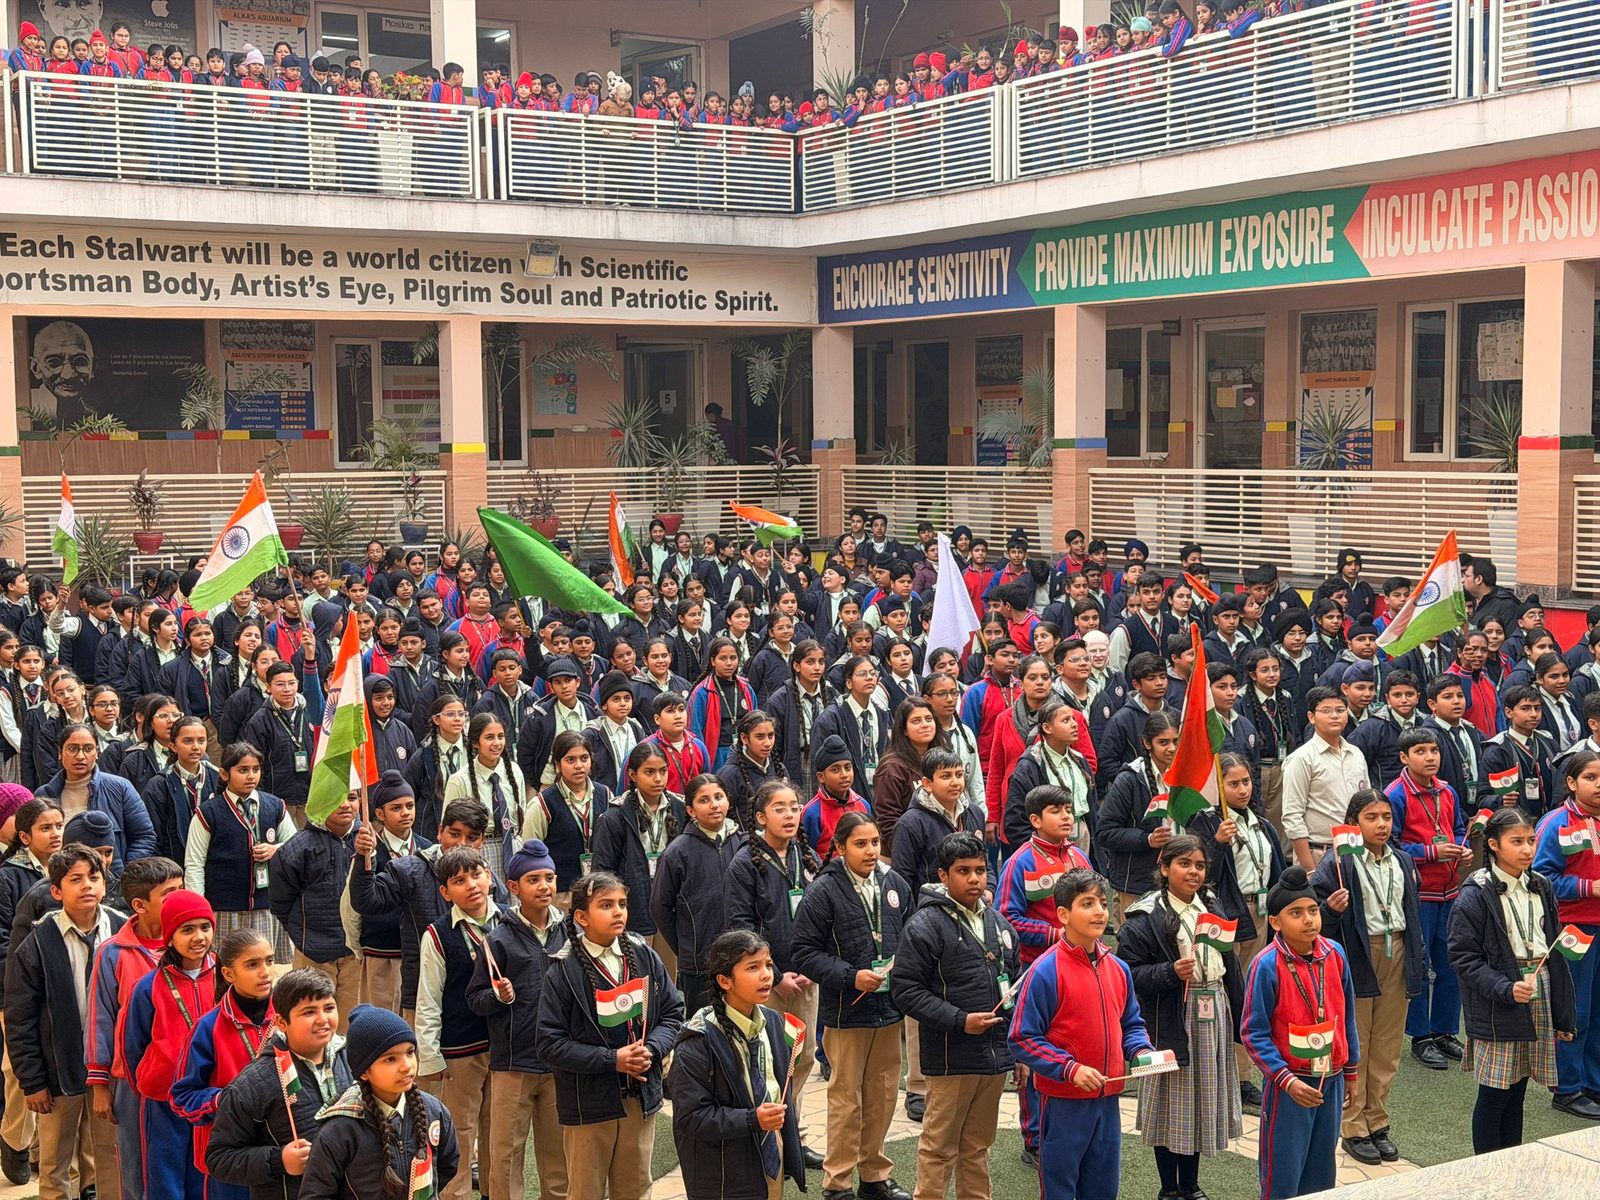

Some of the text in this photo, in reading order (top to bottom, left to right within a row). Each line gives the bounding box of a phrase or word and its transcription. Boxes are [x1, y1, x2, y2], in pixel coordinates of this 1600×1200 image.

[144, 19, 163, 28] Steve
[163, 21, 178, 30] Jobs
[233, 12, 292, 23] ALKA'S AQUARIUM
[1362, 167, 1600, 260] INCULCATE PASSIO
[0, 232, 75, 260] Each
[86, 235, 212, 264] Stalwart
[221, 242, 271, 266] will
[281, 243, 314, 267] be
[323, 251, 338, 268] a
[347, 247, 420, 271] world
[429, 250, 512, 274] citizen
[580, 256, 689, 282] Scientific
[1034, 204, 1335, 292] PROVIDE MAXIMUM EXPOSURE
[143, 271, 221, 301] Body,
[230, 274, 330, 299] Artist's
[340, 276, 394, 305] Eye,
[404, 278, 492, 307] Pilgrim
[500, 282, 552, 306] Soul
[561, 286, 603, 307] and
[611, 287, 708, 311] Patriotic
[714, 290, 779, 316] Spirit.
[832, 246, 1012, 311] ENCOURAGE SENSITIVITY
[665, 394, 671, 404] 5
